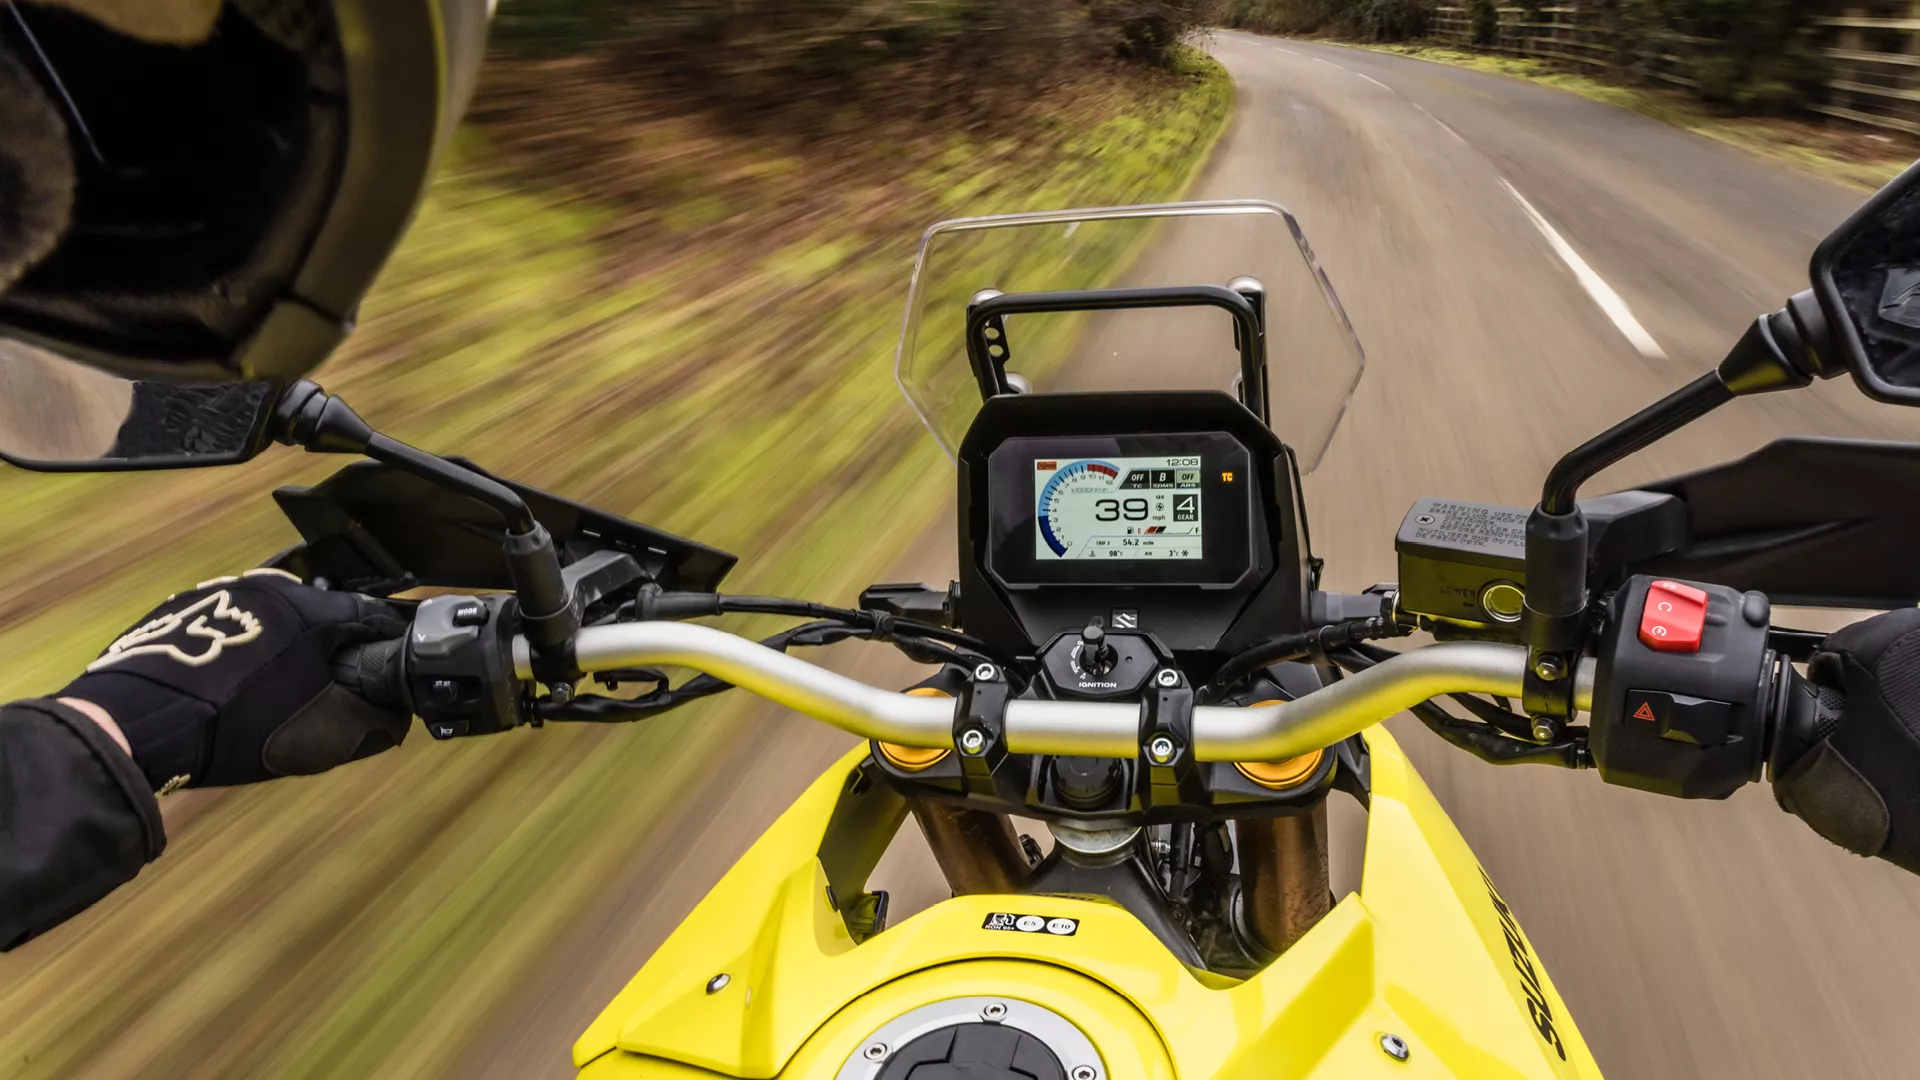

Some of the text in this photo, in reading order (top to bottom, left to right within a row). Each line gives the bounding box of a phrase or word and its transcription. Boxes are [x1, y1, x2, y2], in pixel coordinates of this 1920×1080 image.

[1131, 473, 1144, 481] OFF
[1159, 472, 1166, 482] B
[1221, 472, 1233, 482] TC
[1095, 498, 1149, 521] 39
[1176, 496, 1196, 513] 4
[457, 607, 478, 616] MODE
